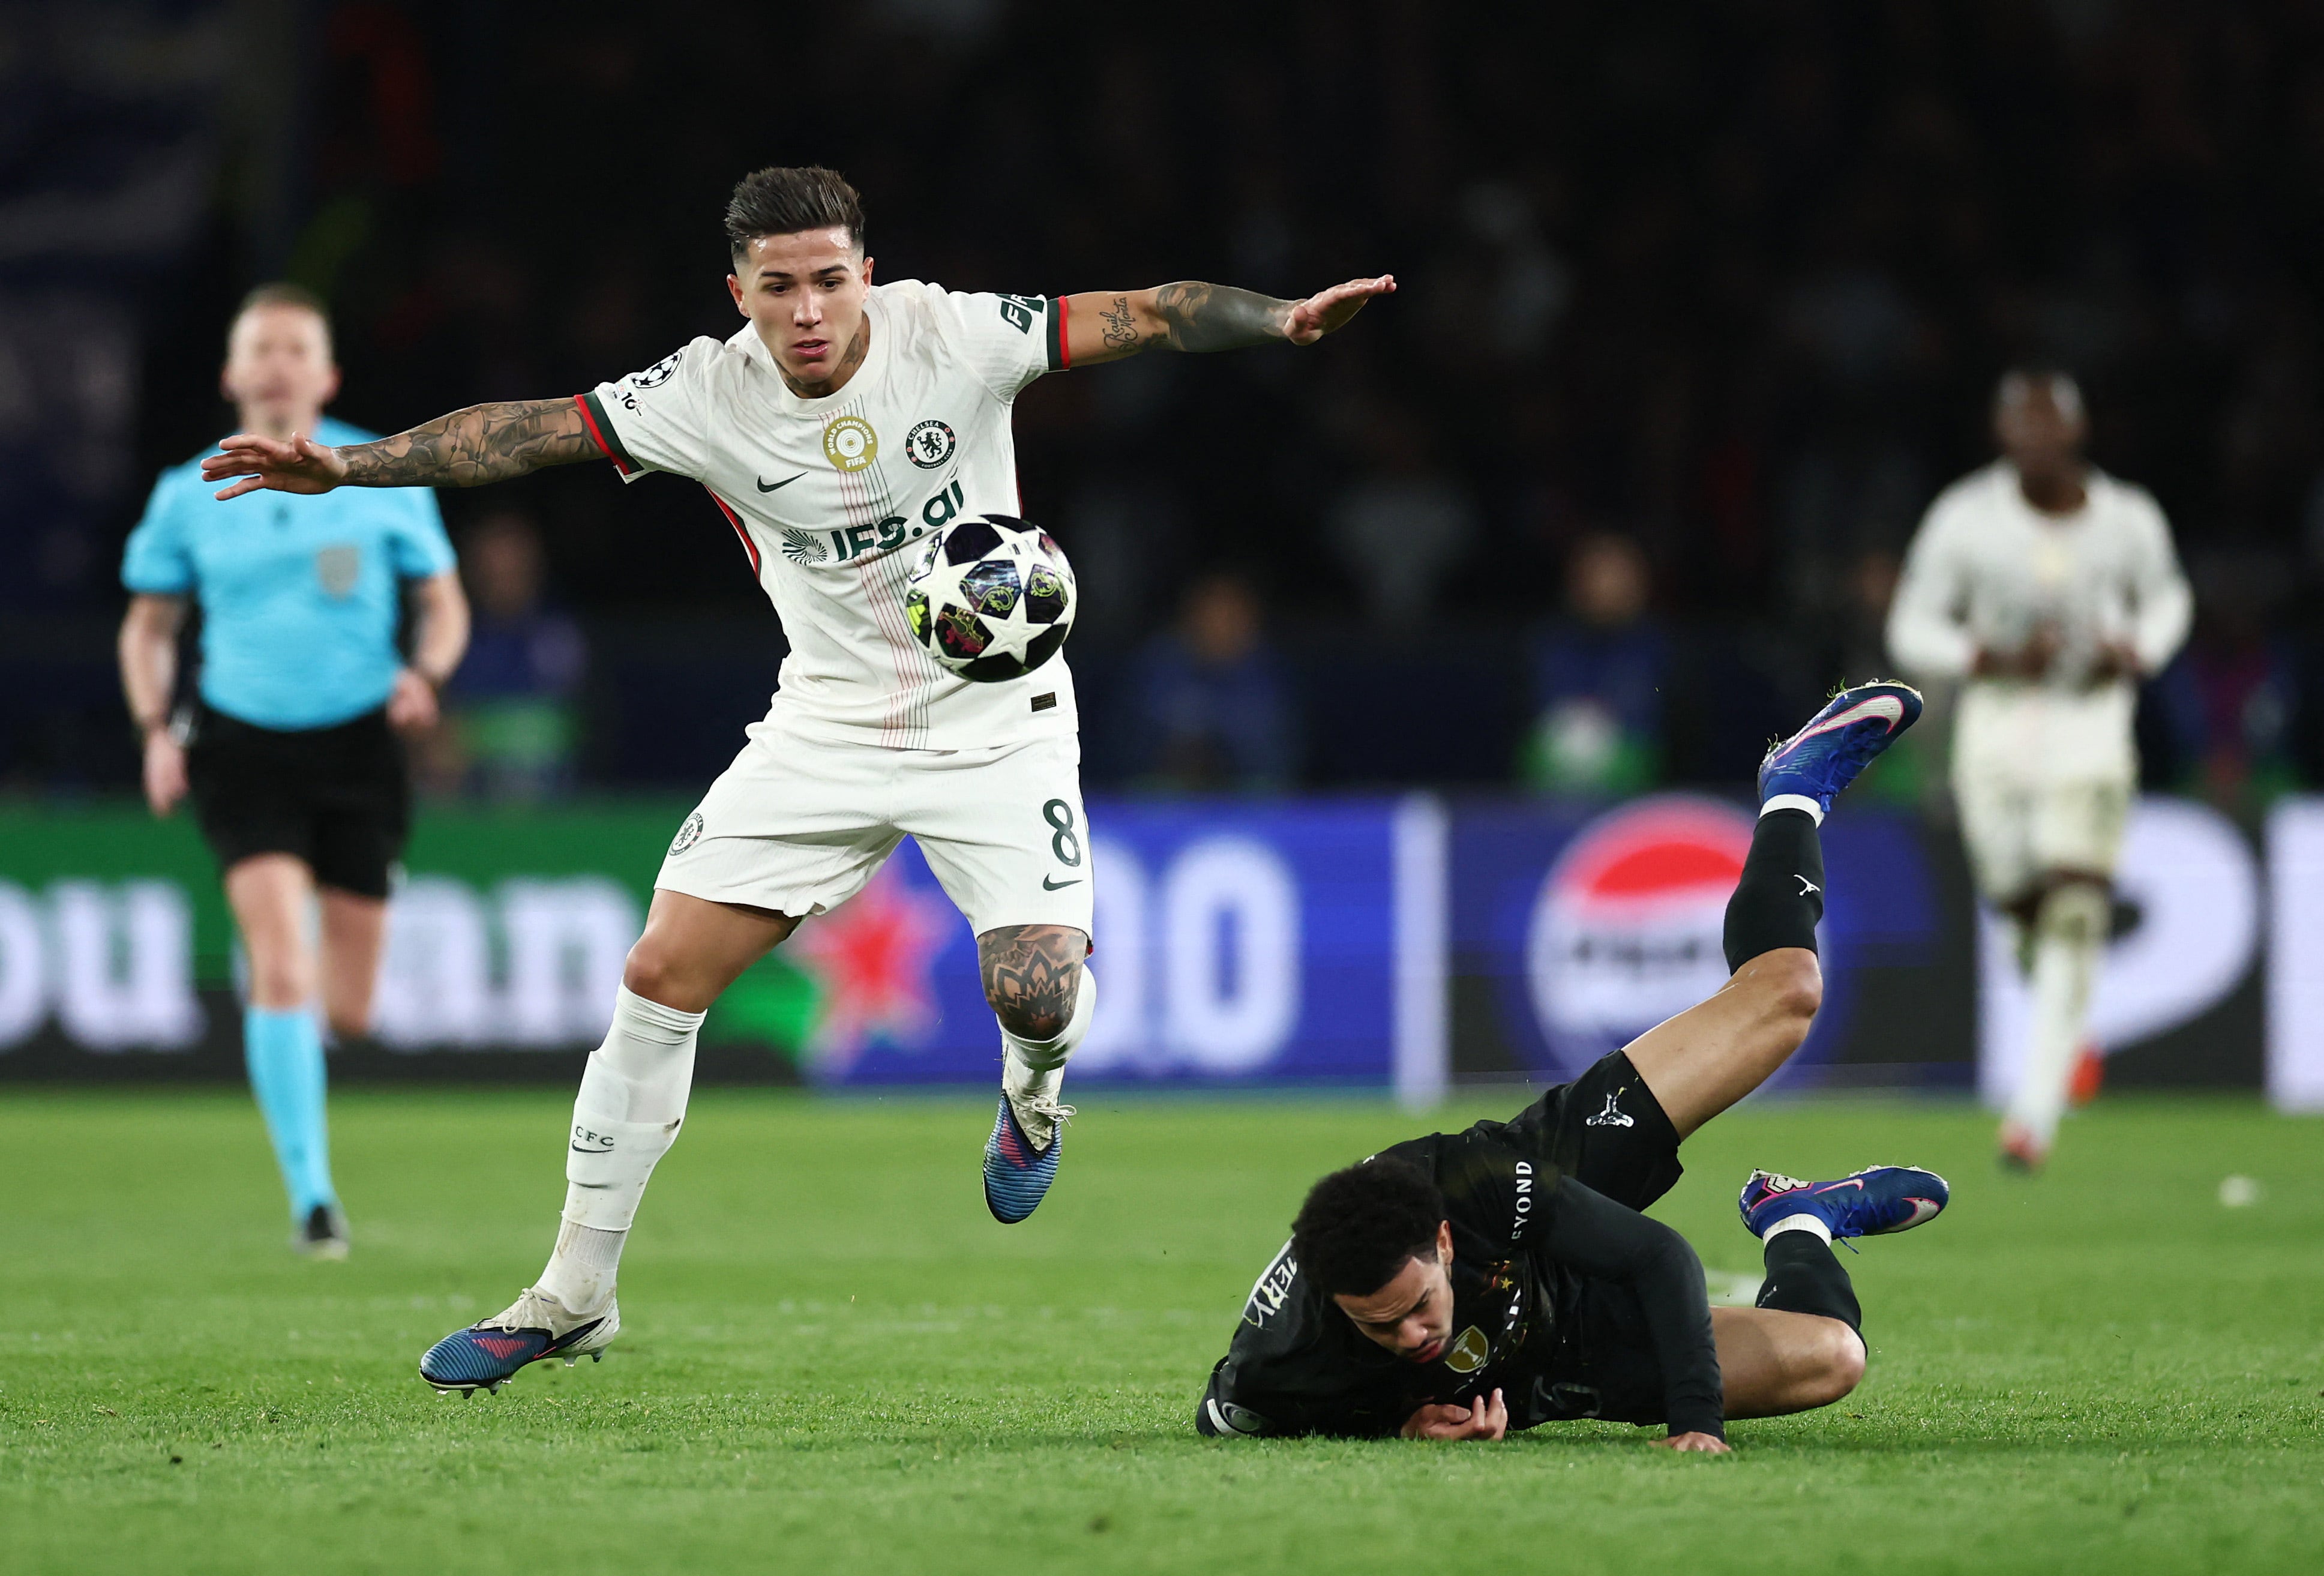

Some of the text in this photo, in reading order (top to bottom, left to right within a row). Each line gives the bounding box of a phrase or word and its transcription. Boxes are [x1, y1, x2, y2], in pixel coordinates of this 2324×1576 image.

[827, 420, 873, 456] WORLD CHAMPIONS
[908, 421, 939, 440] CHELSEA
[845, 456, 867, 468] FIFA
[1043, 799, 1081, 867] 8
[576, 1126, 614, 1146] CFC
